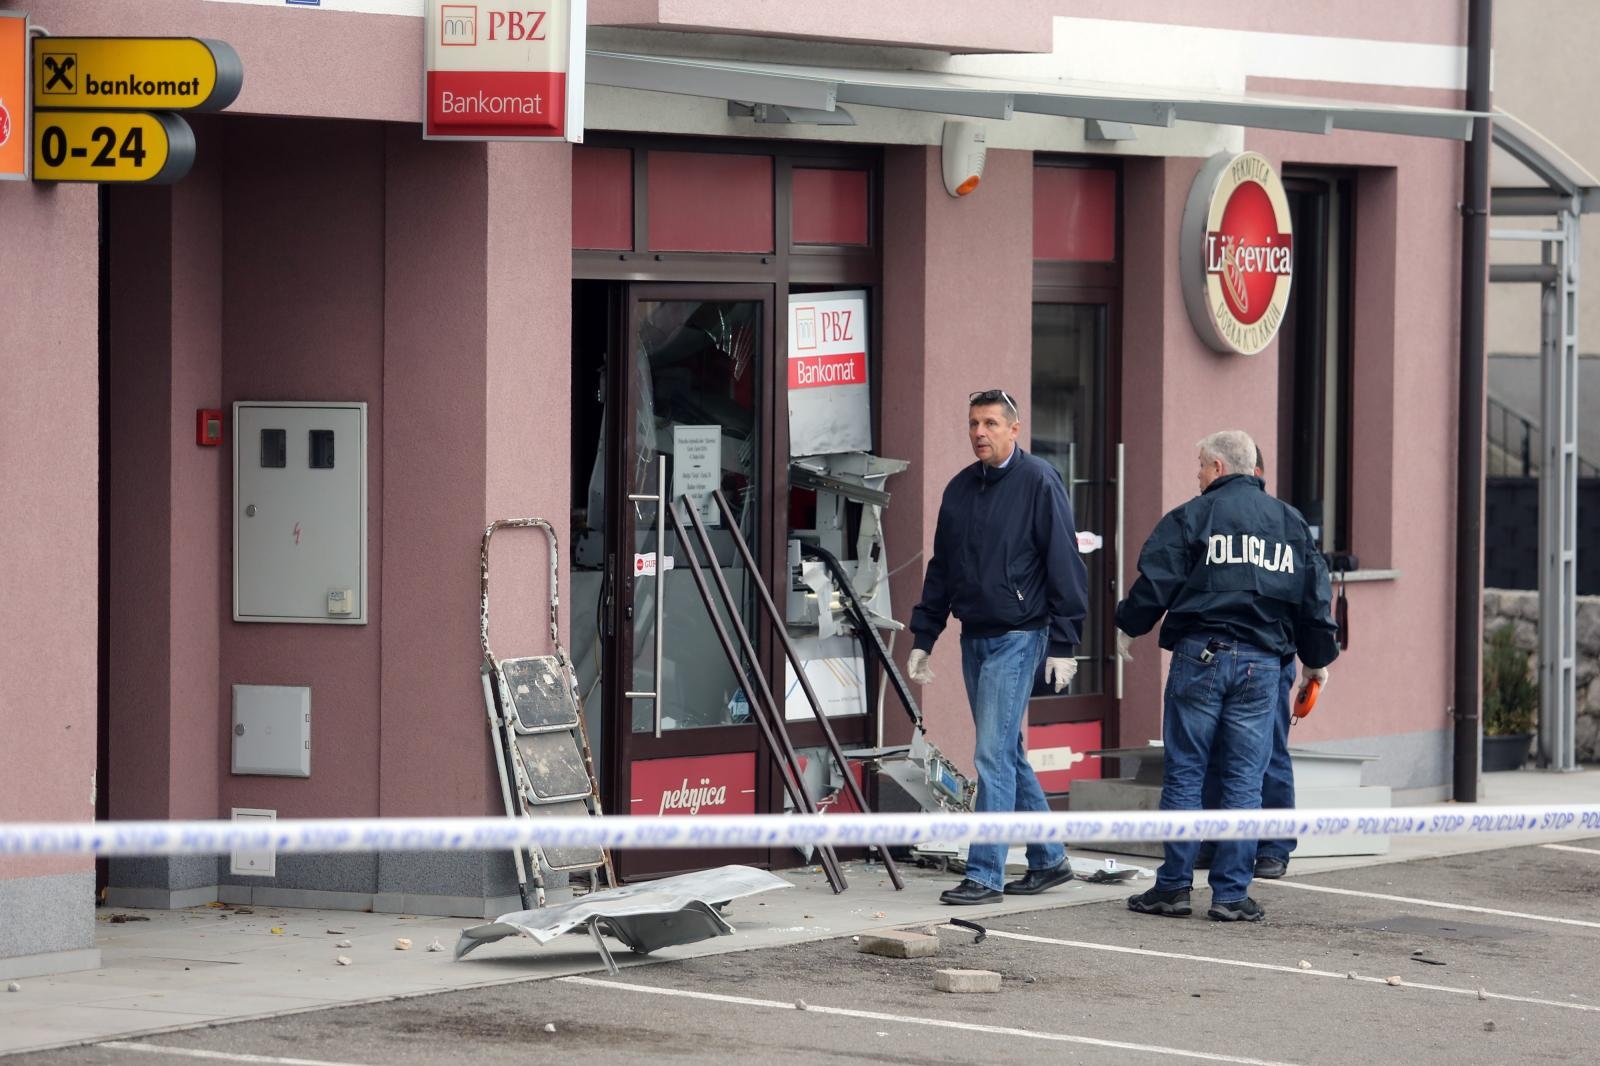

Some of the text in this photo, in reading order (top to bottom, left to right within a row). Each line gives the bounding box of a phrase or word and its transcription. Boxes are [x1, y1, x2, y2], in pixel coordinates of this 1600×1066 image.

[487, 11, 547, 42] PBZ
[85, 73, 200, 96] bankomat
[441, 91, 542, 115] Bankomat
[41, 125, 146, 168] 0-24
[821, 310, 853, 342] PBZ
[797, 359, 855, 384] Bankomat
[658, 778, 726, 817] peknjica
[785, 822, 831, 842] STOP
[928, 821, 970, 840] STOP
[977, 822, 1044, 841] POLICIJA
[1062, 820, 1102, 839] STOP
[1109, 820, 1173, 839] POLICIJA
[1192, 818, 1230, 837] STOP
[1235, 818, 1296, 837] POLICIJA
[1311, 817, 1350, 835] STOP
[1355, 816, 1414, 835] POLICIJA
[1428, 815, 1466, 833] STOP
[1469, 814, 1526, 833] POLICIJA
[1540, 812, 1575, 831] STOP
